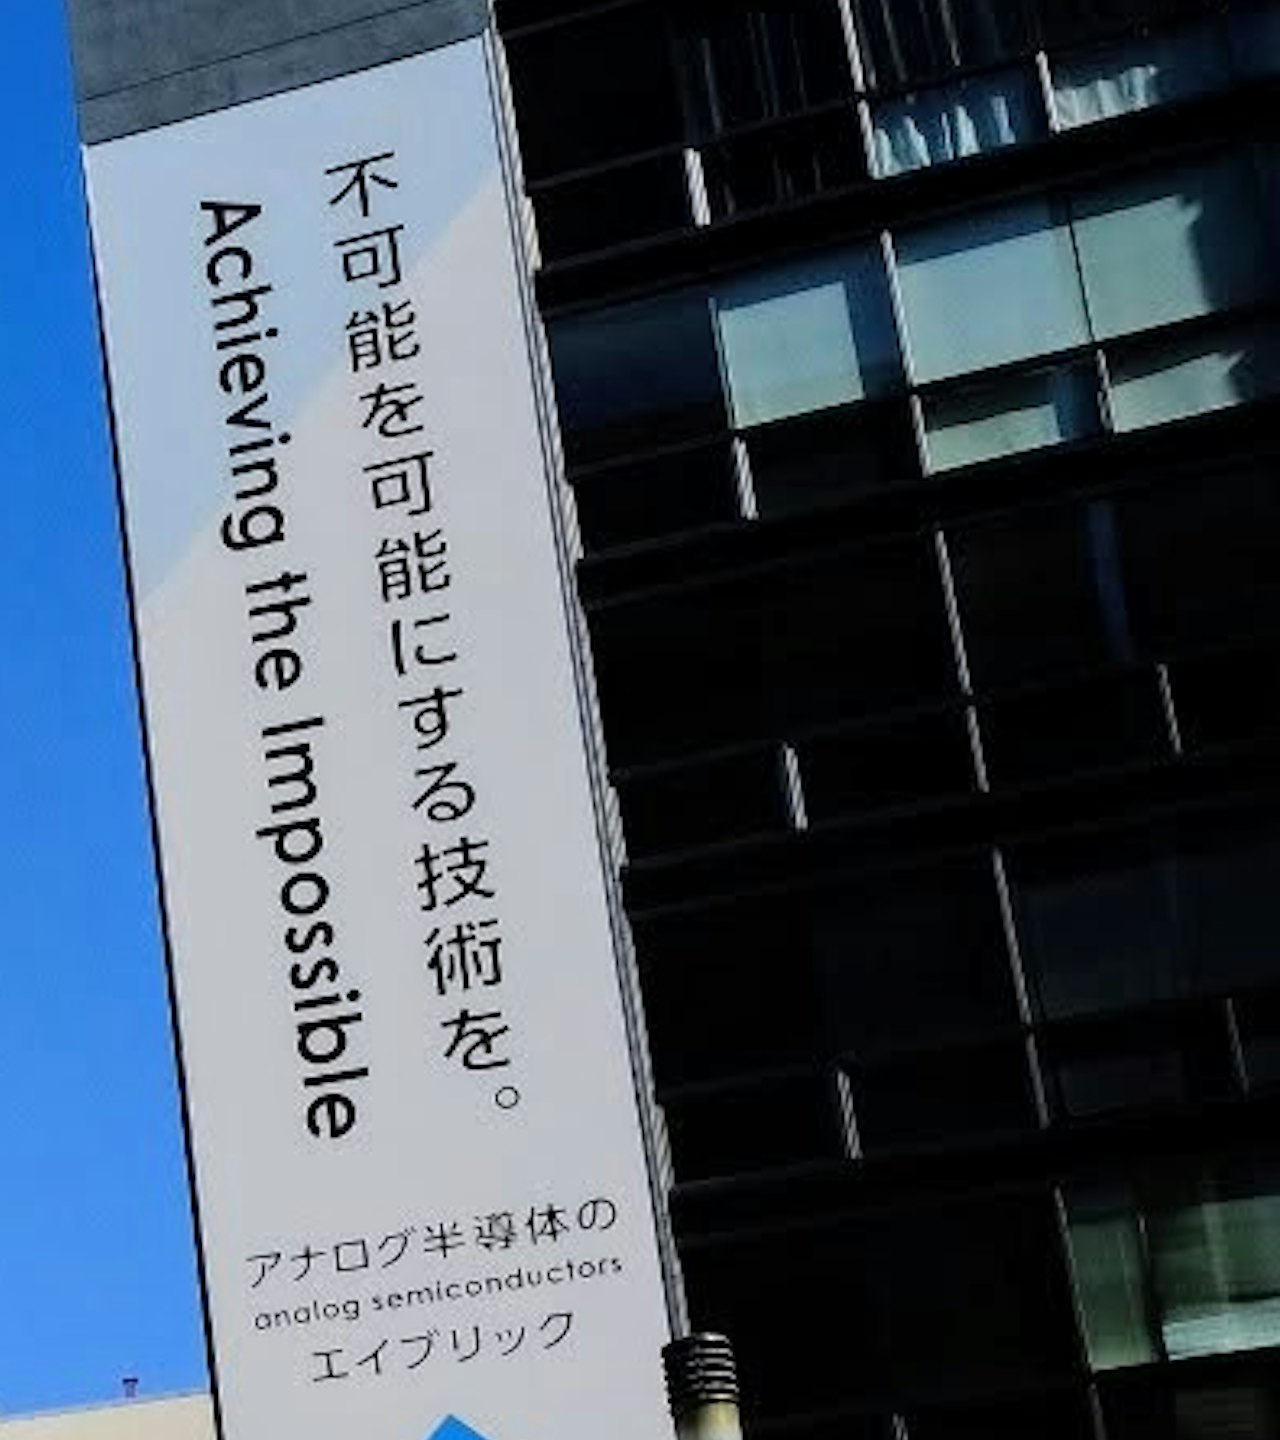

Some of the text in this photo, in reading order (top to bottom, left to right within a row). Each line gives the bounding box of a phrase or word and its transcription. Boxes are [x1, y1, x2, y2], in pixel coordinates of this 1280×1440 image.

[199, 198, 371, 1139] Achieving the Impossible
[327, 152, 521, 1109] 不可能を可能にする技術を。
[246, 1199, 617, 1288] アナログ半導体の
[254, 1257, 623, 1331] analog semiconductors
[312, 1311, 574, 1383] エイブリック
